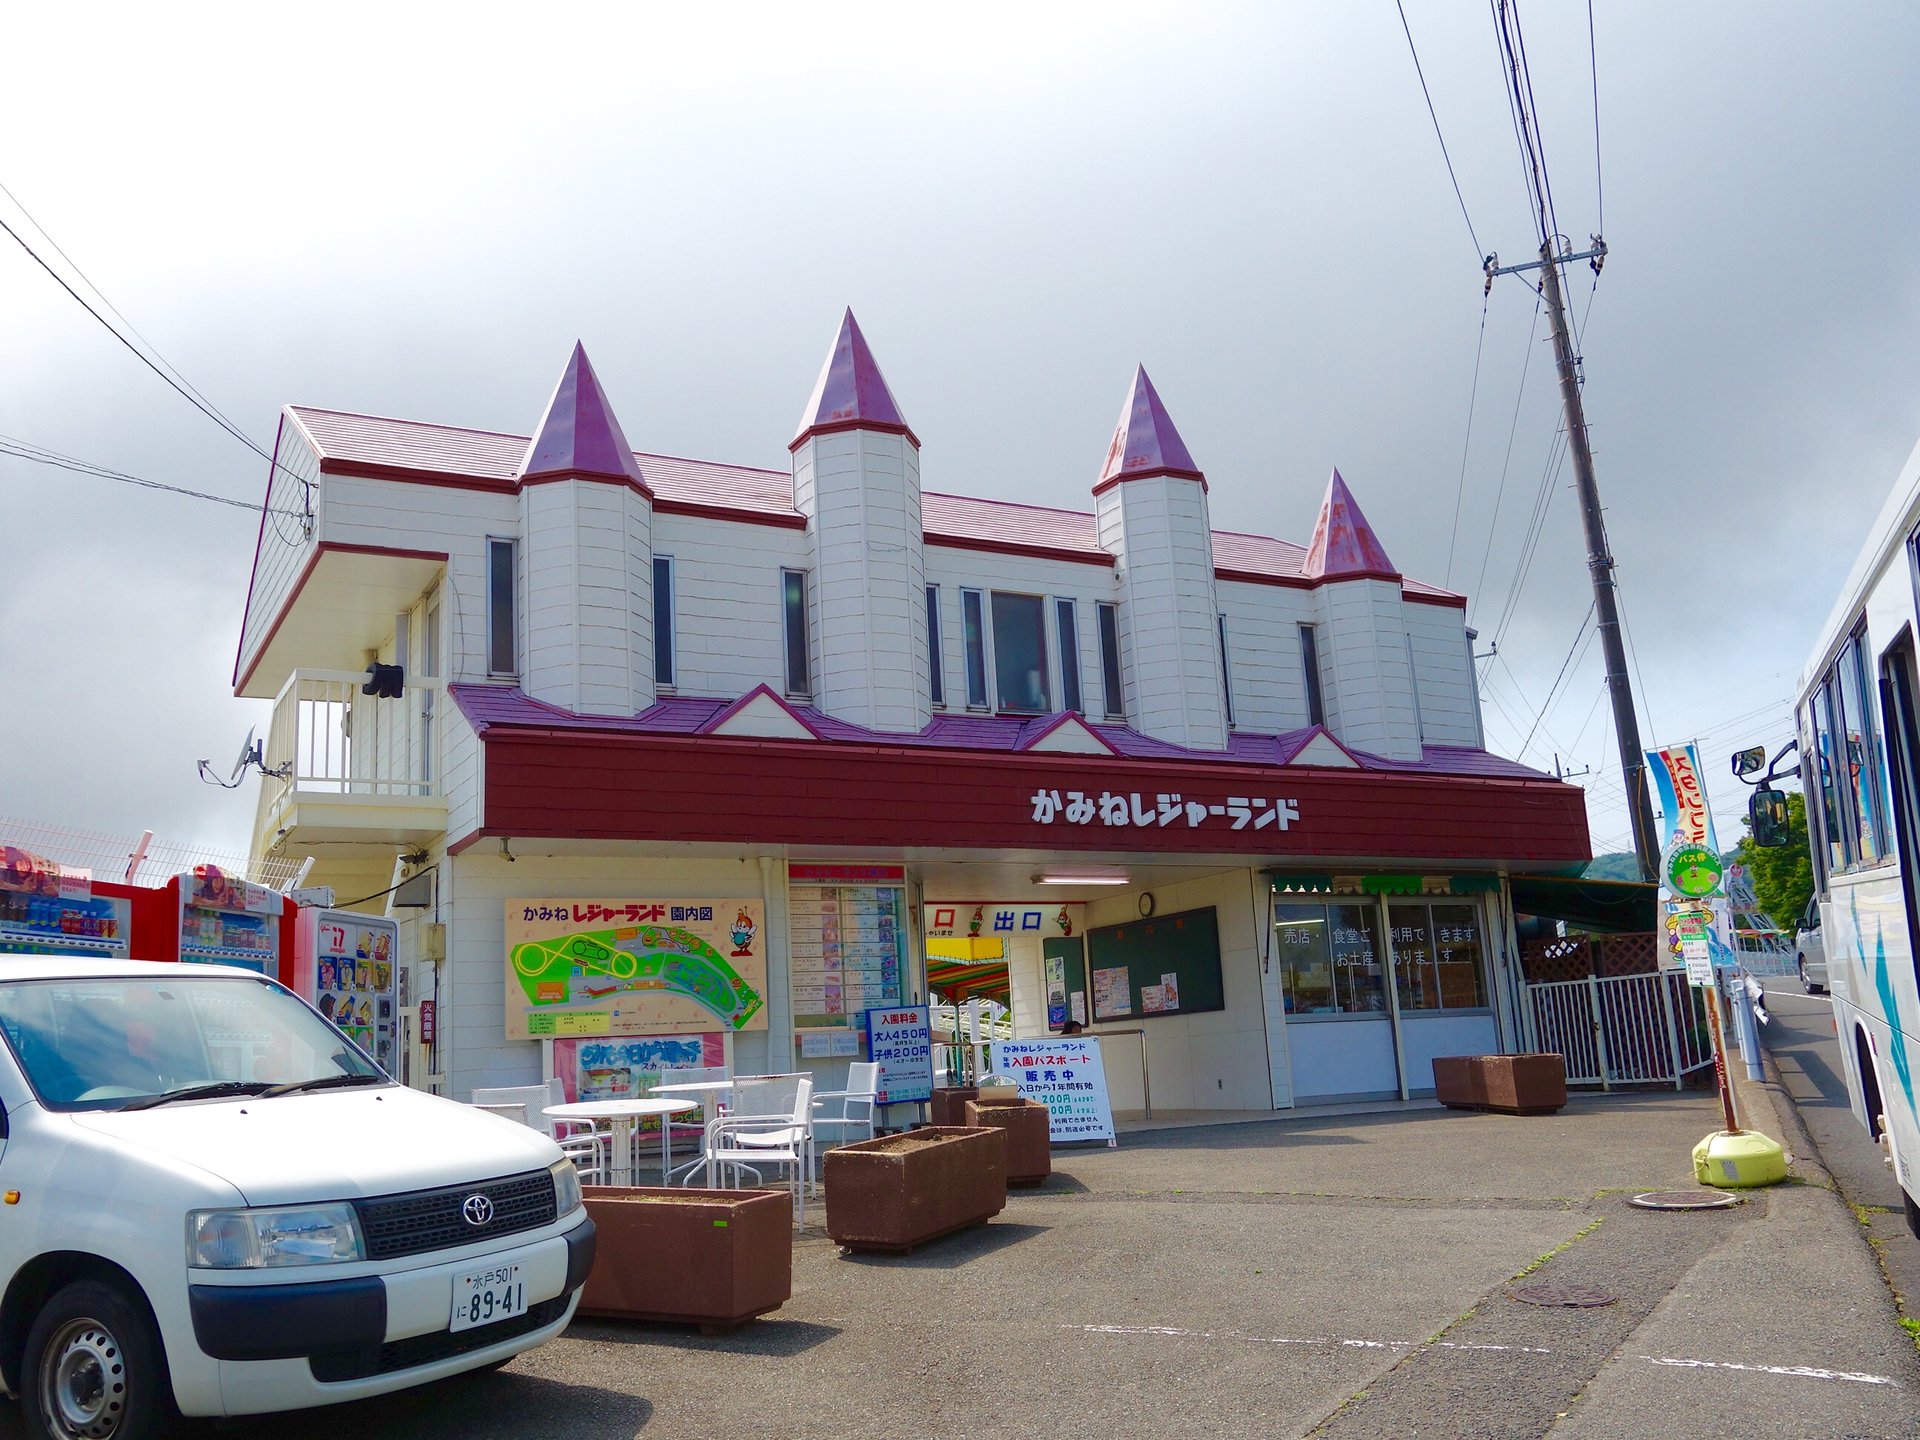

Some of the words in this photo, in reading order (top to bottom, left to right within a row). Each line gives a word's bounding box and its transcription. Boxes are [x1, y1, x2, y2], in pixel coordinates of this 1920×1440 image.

[1030, 788, 1300, 831] かみねレジャーランド
[994, 911, 1041, 931] 出口
[881, 1012, 918, 1025] 入園料金
[874, 1028, 928, 1042] 大人450円
[874, 1045, 929, 1060] 子供200円
[1003, 1043, 1086, 1053] かみねレジャーランド
[1011, 1054, 1091, 1067] 入園パスポート
[470, 1283, 522, 1322] 89-41
